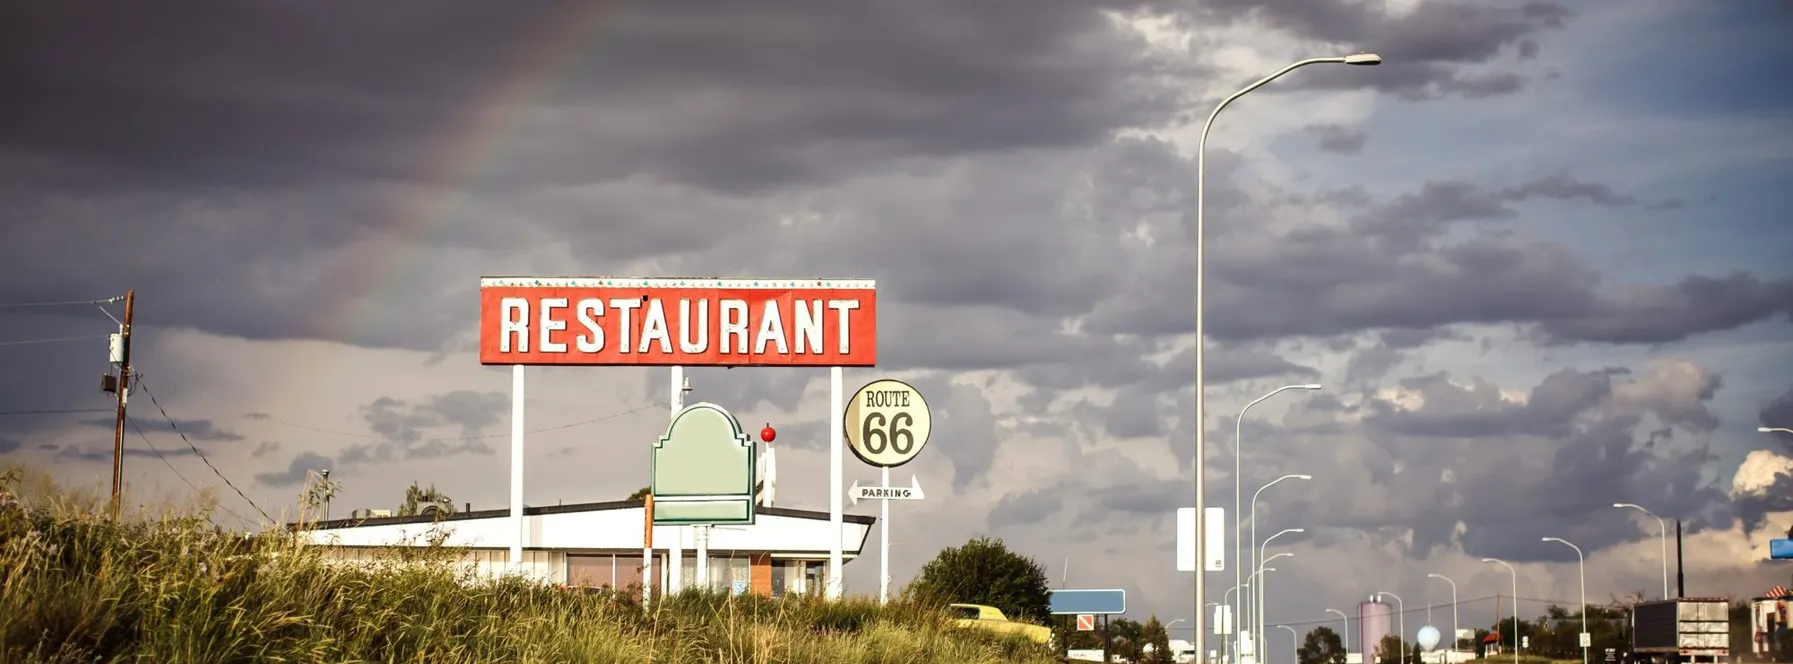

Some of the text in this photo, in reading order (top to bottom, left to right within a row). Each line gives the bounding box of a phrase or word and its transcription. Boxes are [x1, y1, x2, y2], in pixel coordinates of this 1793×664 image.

[500, 297, 859, 353] RESTAURANT
[866, 390, 910, 407] ROUTE
[863, 412, 914, 455] 66
[862, 488, 912, 498] PARKING
